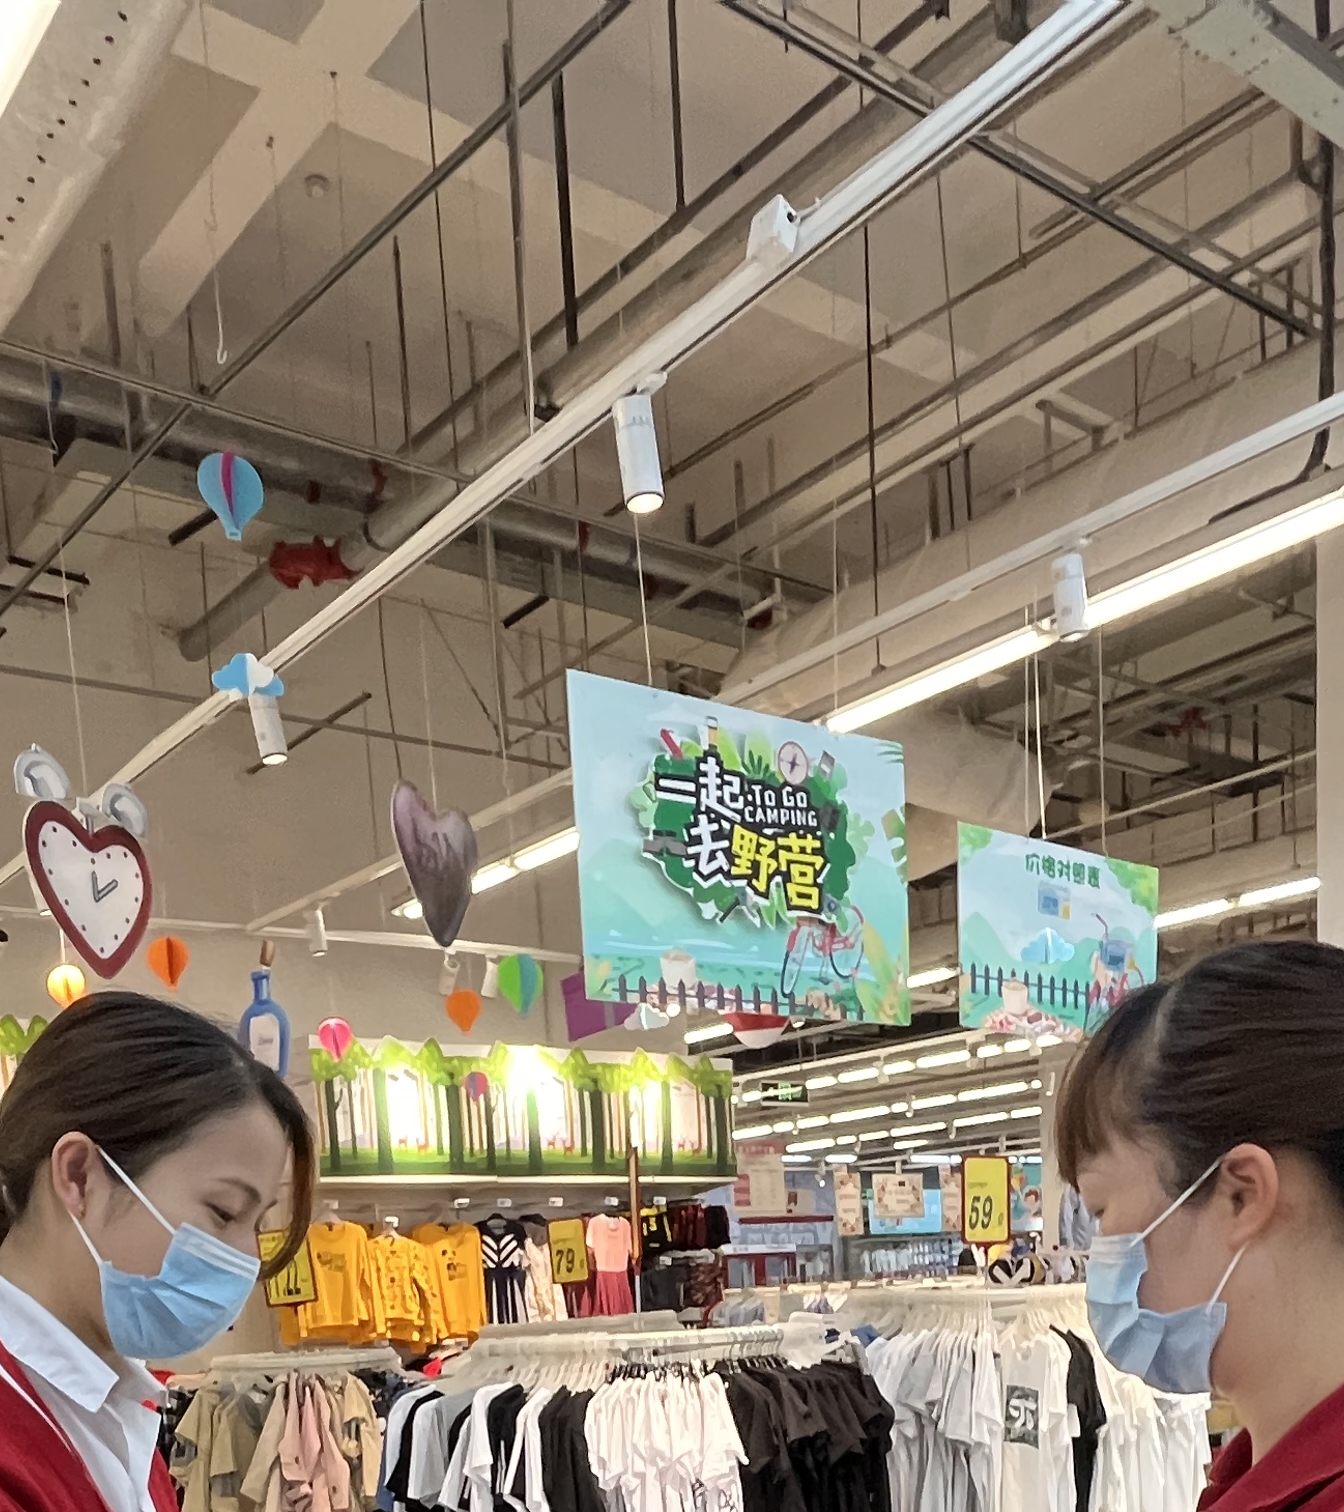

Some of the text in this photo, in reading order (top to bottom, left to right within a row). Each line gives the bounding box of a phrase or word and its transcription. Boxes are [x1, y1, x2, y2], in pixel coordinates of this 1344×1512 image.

[657, 756, 745, 823] 一起
[744, 805, 818, 827] CAMPING
[687, 814, 824, 910] 去野营
[967, 1195, 992, 1230] 59
[555, 1247, 576, 1276] 79
